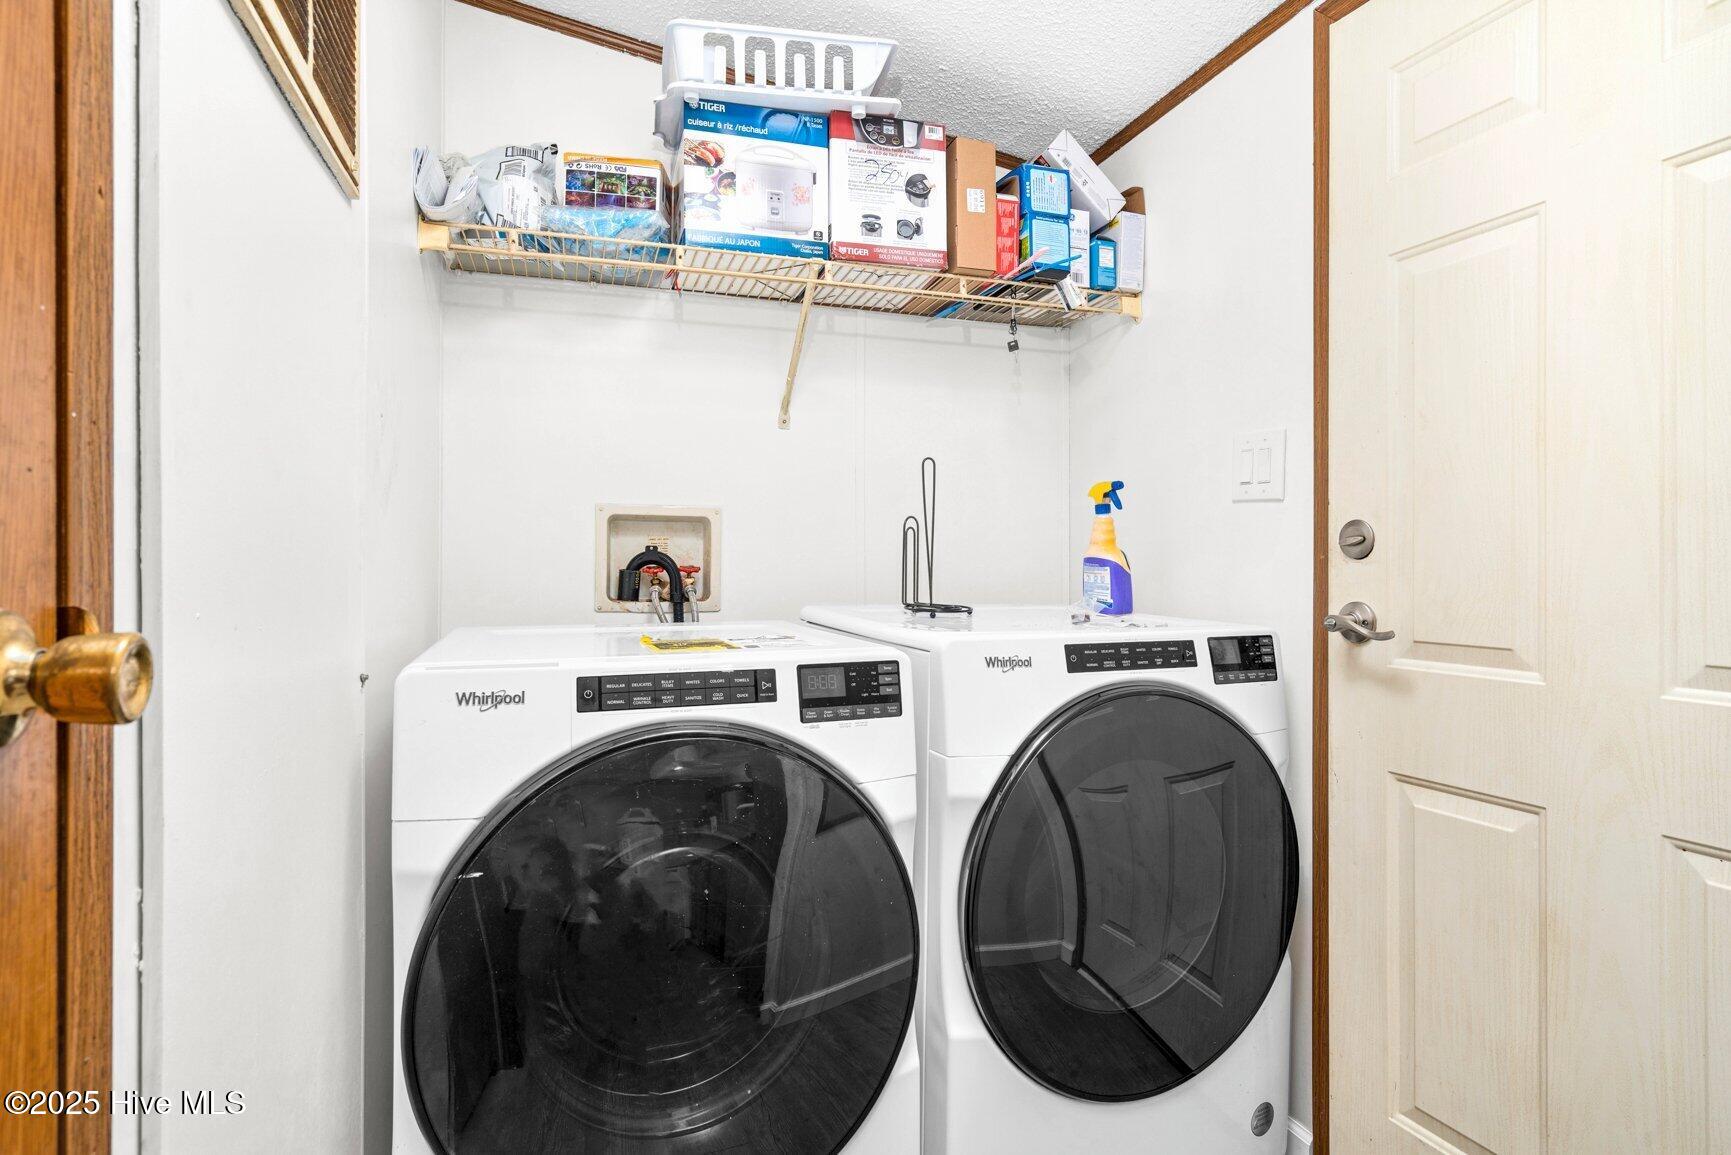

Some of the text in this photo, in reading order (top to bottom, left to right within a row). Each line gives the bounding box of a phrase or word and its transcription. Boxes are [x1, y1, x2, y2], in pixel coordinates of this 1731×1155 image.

[700, 102, 726, 112] TIGER
[688, 118, 715, 128] cuiseur
[724, 122, 733, 130] riz
[737, 239, 760, 247] JAPON
[848, 247, 869, 256] TIGER
[984, 655, 1032, 672] Whirlpool
[456, 690, 525, 711] Whirlpool
